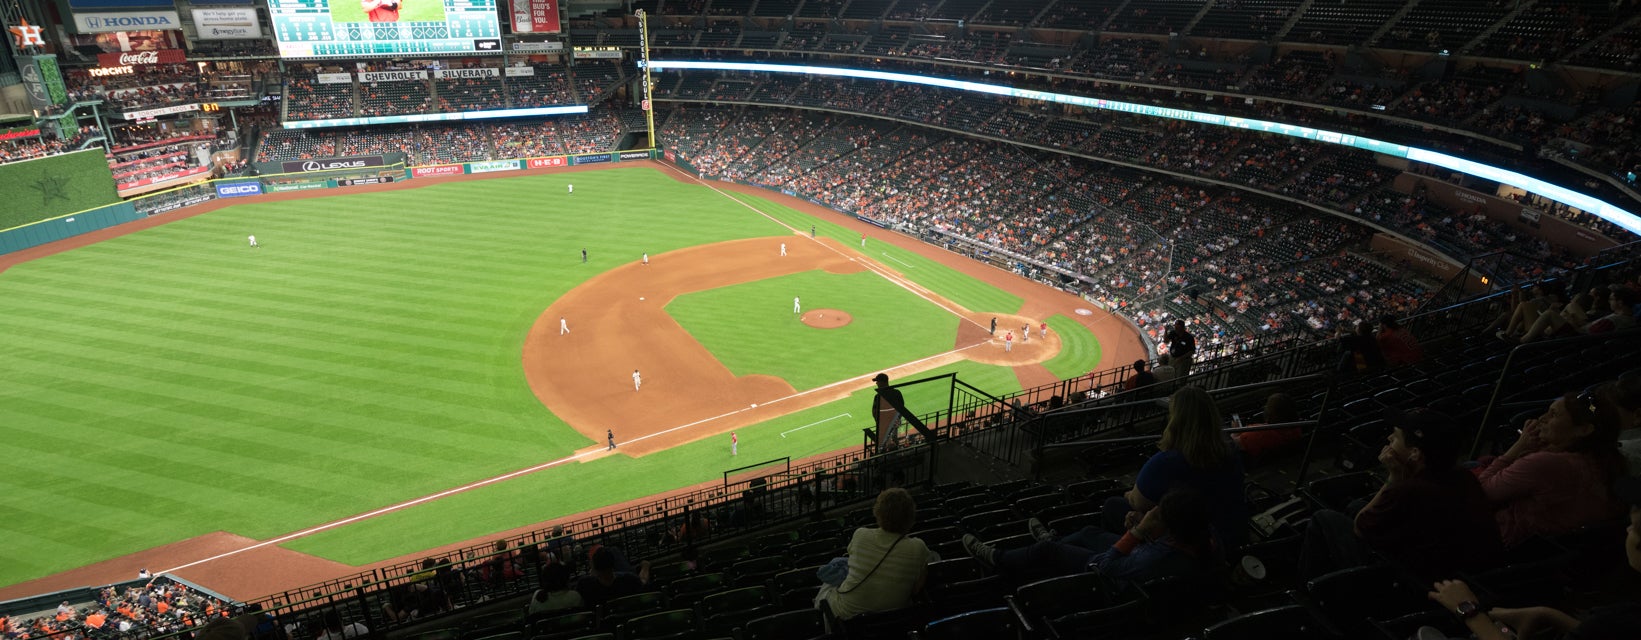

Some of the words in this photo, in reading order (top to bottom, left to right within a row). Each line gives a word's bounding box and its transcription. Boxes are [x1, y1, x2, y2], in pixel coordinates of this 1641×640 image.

[103, 16, 171, 27] HONDA
[120, 51, 159, 66] Coca-Cola
[88, 65, 134, 77] TORCHYS
[365, 71, 421, 81] CHEVROLET
[442, 69, 493, 79] SILVERADO
[138, 109, 165, 118] TORCHYS
[169, 105, 187, 113] TACOS
[321, 160, 366, 170] LEXUS
[220, 185, 259, 195] GEICO
